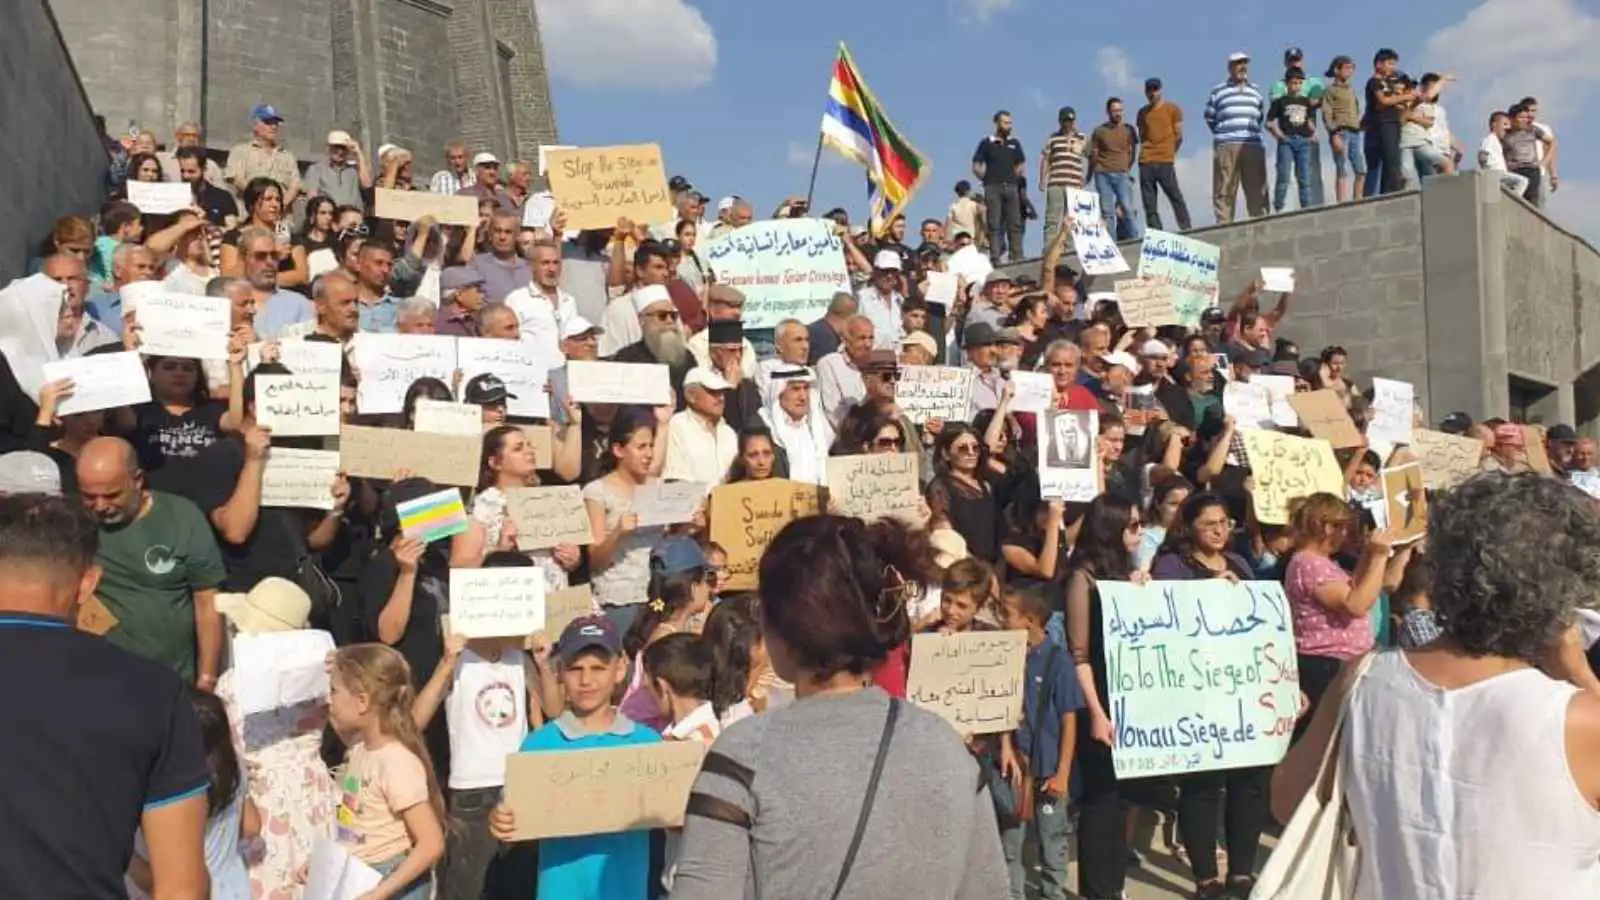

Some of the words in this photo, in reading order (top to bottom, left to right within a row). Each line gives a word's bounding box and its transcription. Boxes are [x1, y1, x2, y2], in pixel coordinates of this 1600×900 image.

[1110, 640, 1135, 693] No
[1129, 644, 1154, 688] To
[1151, 643, 1186, 689] The
[1189, 648, 1243, 696] Siege
[1113, 696, 1150, 750] Non
[1149, 725, 1175, 749] au
[1177, 712, 1232, 759] Siège
[1232, 697, 1257, 743] de
